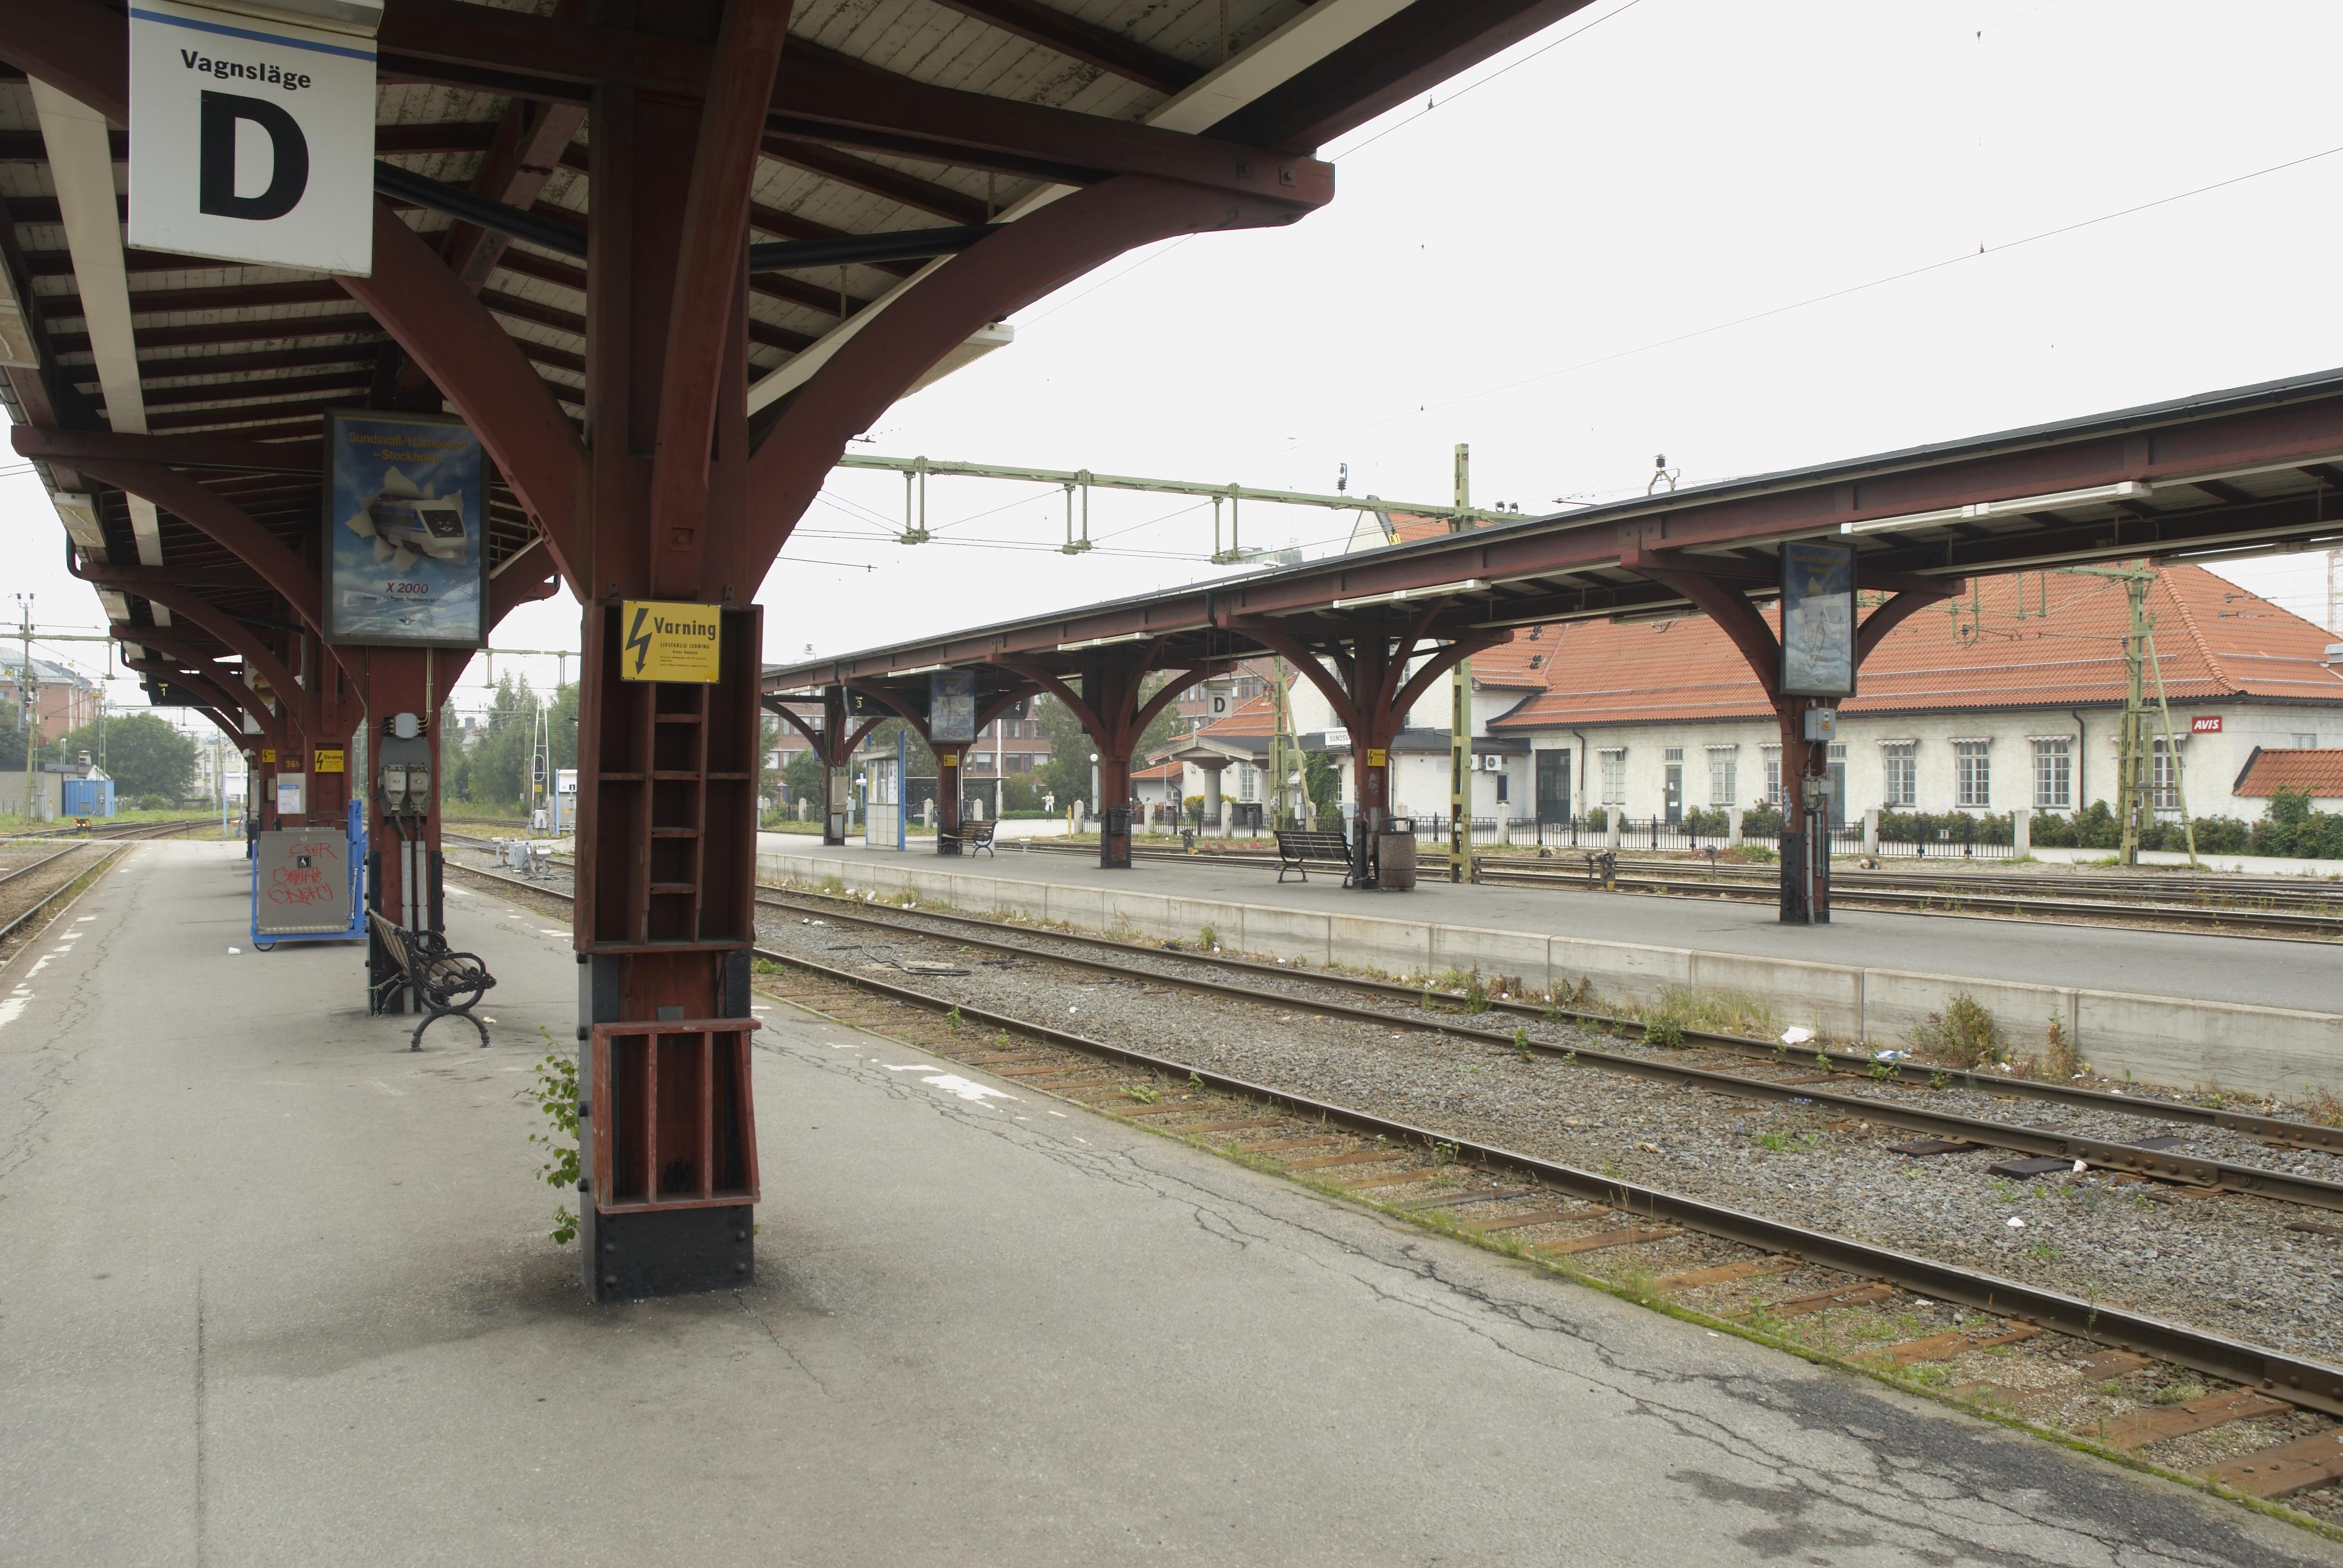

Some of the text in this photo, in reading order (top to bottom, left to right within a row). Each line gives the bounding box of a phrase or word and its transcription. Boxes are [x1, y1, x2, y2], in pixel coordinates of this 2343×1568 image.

[180, 48, 311, 90] Vagnsläge
[200, 89, 309, 221] D
[386, 583, 429, 594] X 2000
[654, 617, 716, 641] Varning
[161, 687, 165, 696] 1
[856, 700, 862, 708] 3
[1214, 697, 1225, 713] D
[2194, 719, 2220, 730] AVIS
